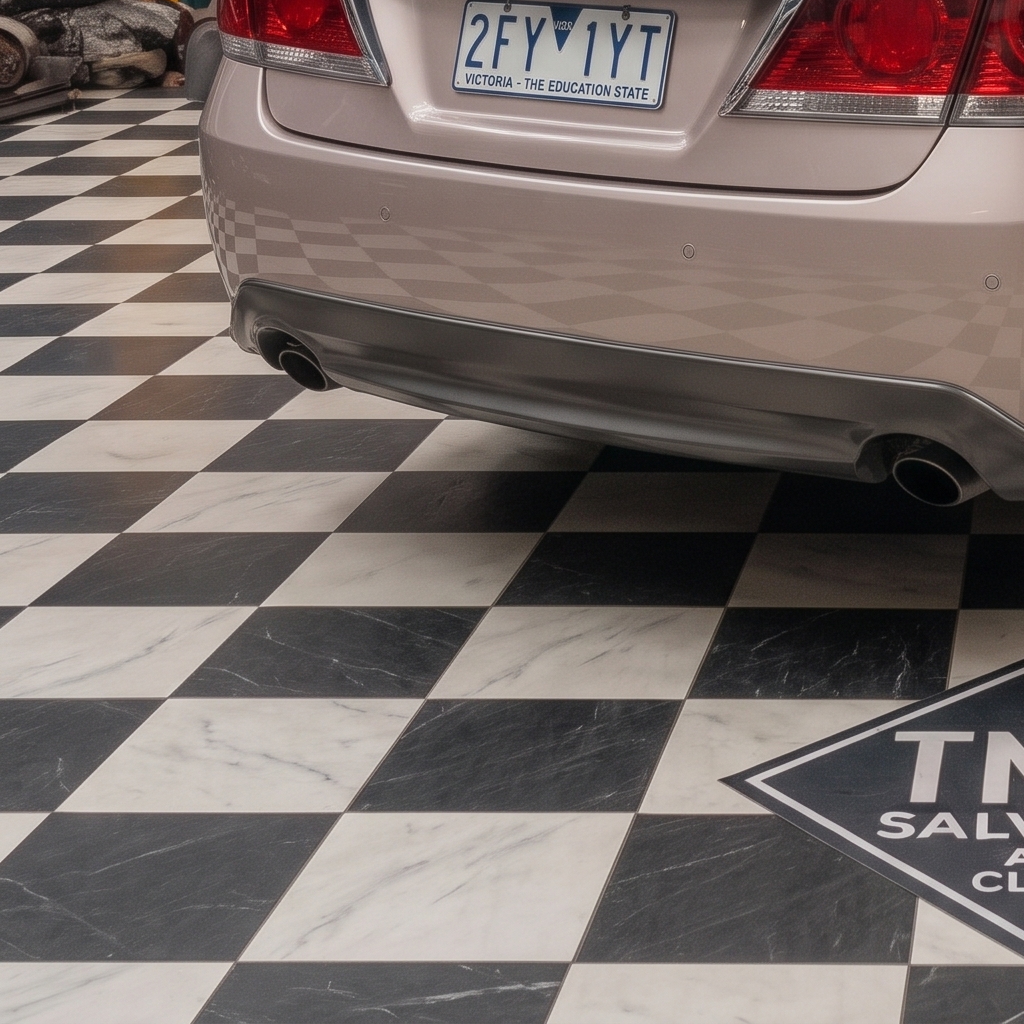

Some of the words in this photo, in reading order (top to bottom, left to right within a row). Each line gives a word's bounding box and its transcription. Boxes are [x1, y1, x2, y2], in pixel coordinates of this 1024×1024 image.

[464, 13, 547, 73] 2FY
[583, 20, 662, 82] 1YT
[465, 73, 513, 88] VICTORIA
[524, 77, 545, 91] THE
[548, 80, 611, 97] EDUCATION
[614, 85, 649, 101] STATE
